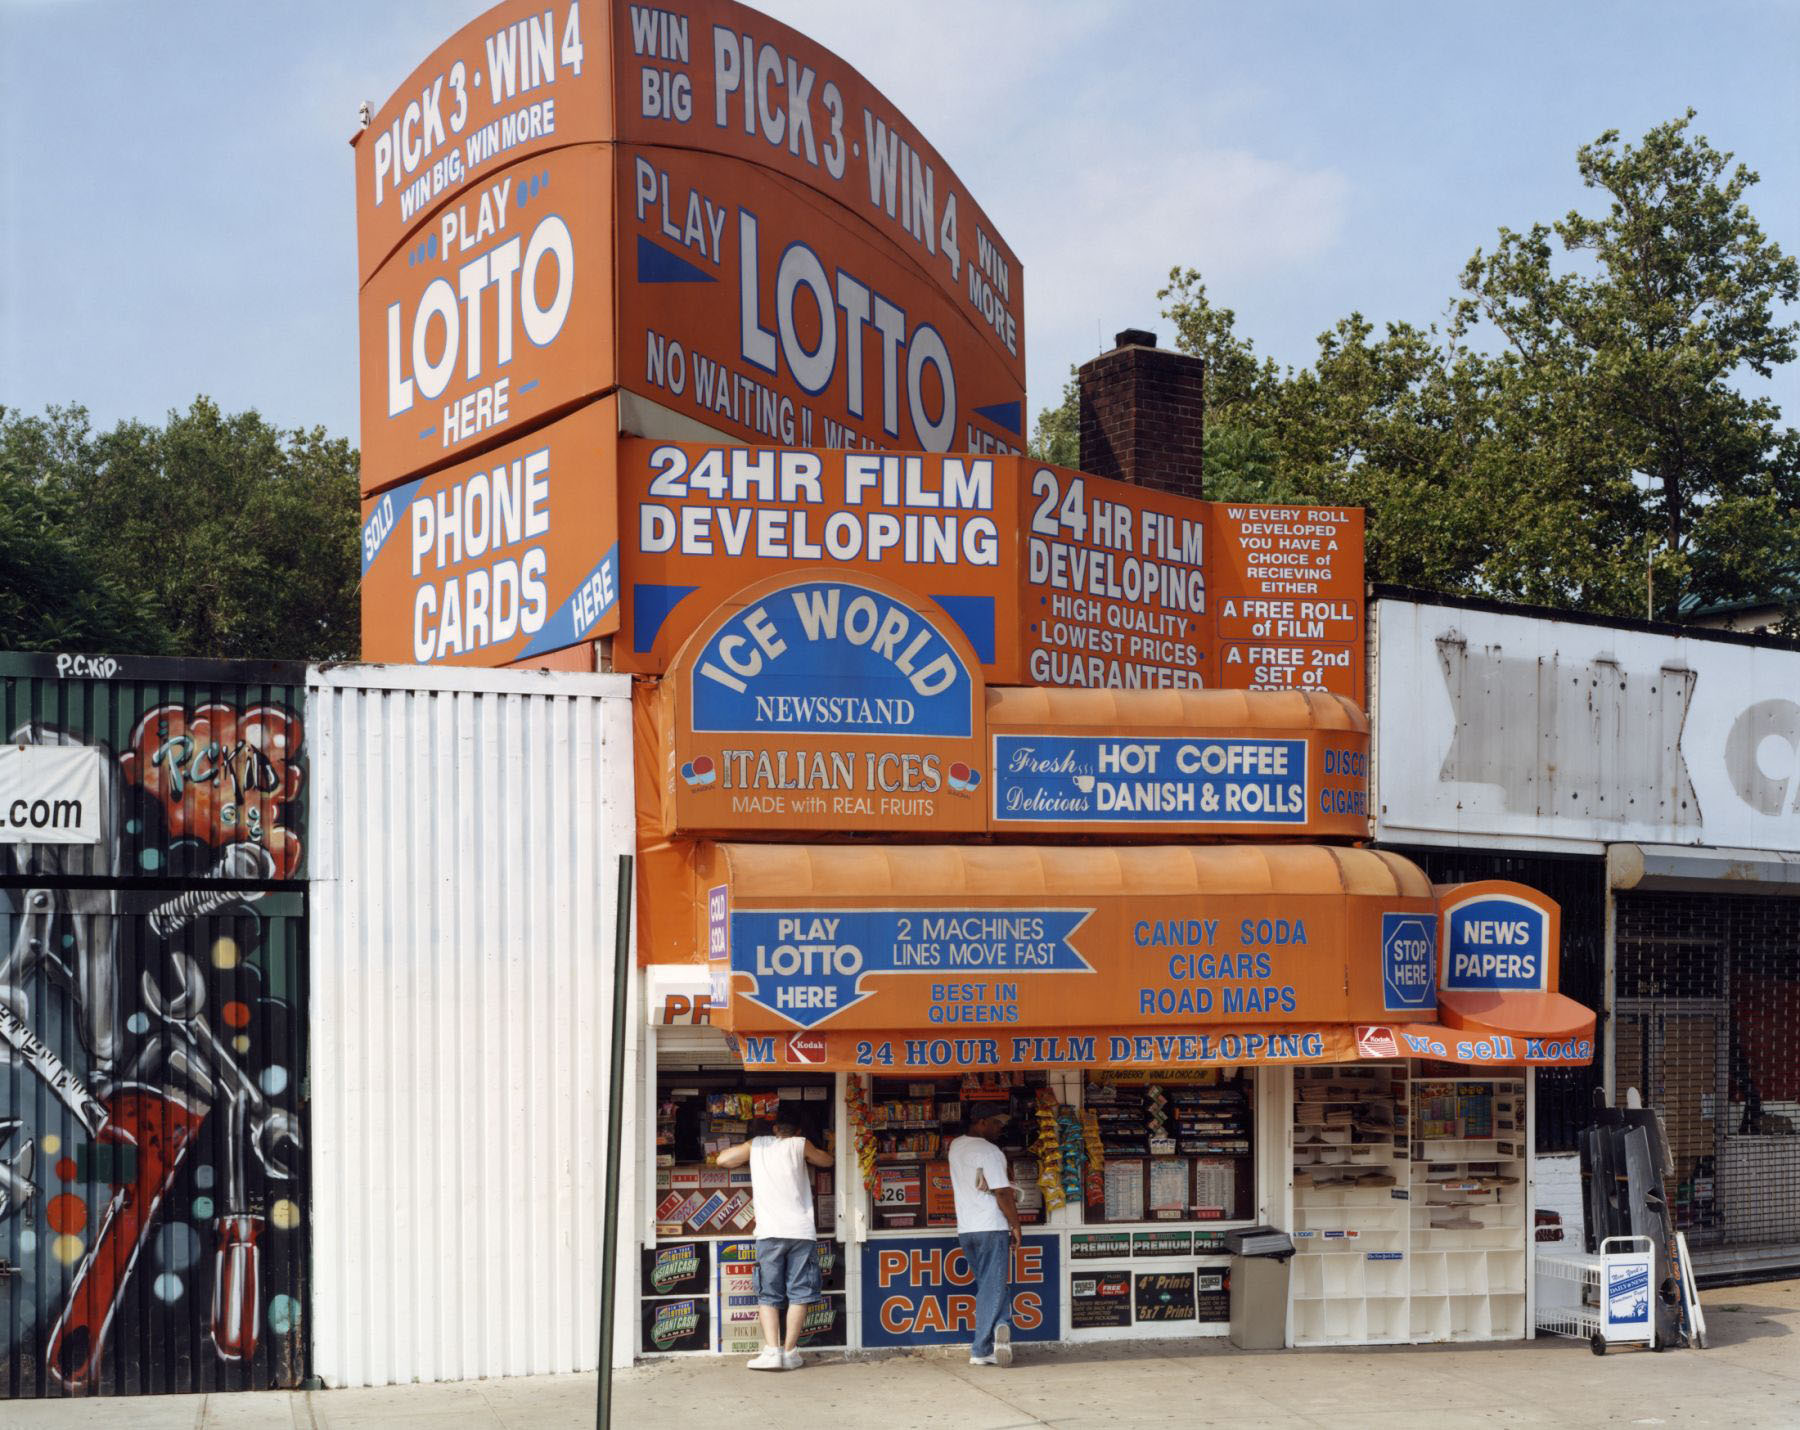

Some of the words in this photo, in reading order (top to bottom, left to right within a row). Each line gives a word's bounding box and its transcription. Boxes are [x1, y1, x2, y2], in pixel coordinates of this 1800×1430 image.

[630, 5, 690, 64] WIN
[375, 75, 446, 207] PICK
[449, 60, 468, 134] 3
[486, 10, 556, 104] WIN
[561, 0, 584, 76] 4
[641, 66, 693, 124] BIG
[400, 172, 431, 223] WIN
[433, 148, 464, 196] BIG,
[466, 120, 499, 168] WIN
[502, 99, 555, 150] MORE
[712, 23, 819, 168] PICK
[822, 80, 845, 181] 3
[863, 106, 936, 256] WIN
[940, 190, 960, 284] 4
[442, 176, 511, 262] PLAY
[635, 154, 726, 266] PLAY
[975, 224, 1009, 303] WIN
[388, 213, 575, 419] LOTTO
[967, 260, 1017, 358] MORE
[739, 206, 957, 452] LOTTO
[646, 328, 686, 396] NO
[692, 351, 795, 446] WAITING
[443, 378, 510, 448] HERE
[649, 446, 824, 504] 24HR
[845, 453, 994, 511] FILM
[411, 446, 549, 579] PHONE
[1031, 467, 1089, 543] 24
[1092, 498, 1133, 553] HR
[1141, 509, 1203, 568] FILM
[1308, 511, 1349, 523] ROLL
[364, 494, 394, 561] SOLD
[639, 502, 999, 567] DEVELOPING
[1241, 523, 1336, 536] DEVELOPED
[1239, 537, 1272, 549] YOU
[1279, 538, 1320, 550] HAVE
[1327, 540, 1338, 551] A
[1247, 552, 1309, 565] CHOICE
[1315, 554, 1331, 565] of
[1029, 536, 1205, 615] DEVELOPING
[1247, 567, 1332, 580] RECIEVING
[1261, 581, 1318, 594] EITHER
[413, 546, 547, 664] CARDS
[571, 559, 614, 639] HERE
[1223, 601, 1237, 617] A
[1243, 601, 1294, 618] FREE
[1301, 602, 1354, 621] ROLL
[1052, 594, 1101, 625] HIGH
[1106, 604, 1188, 638] QUALITY
[1252, 619, 1272, 637] of
[1277, 621, 1324, 638] FILM
[700, 606, 788, 694] ICE
[791, 588, 958, 697] WORLD
[1040, 619, 1124, 657] LOWEST
[1129, 635, 1198, 667] PRICES
[1226, 647, 1242, 664] A
[1249, 647, 1305, 665] FREE
[1311, 649, 1349, 666] 2nd
[1255, 666, 1293, 684] SET
[1302, 666, 1324, 684] of
[755, 696, 915, 725] NEWSSTAND
[721, 750, 856, 790] ITALIAN
[866, 752, 942, 793] ICES
[1008, 747, 1075, 774] Fresh
[1099, 745, 1160, 773] HOT
[1176, 745, 1289, 775] COFFEE
[732, 796, 785, 814] MADE
[792, 797, 827, 814] with
[833, 797, 875, 815] REAL
[881, 798, 935, 817] FRUITS
[1006, 786, 1090, 812] Delicious
[1097, 783, 1195, 811] DANISH
[1200, 783, 1220, 812] &
[1225, 784, 1304, 814] ROLLS
[711, 894, 725, 922] COLD
[711, 926, 726, 953] SODA
[778, 918, 840, 941] PLAY
[897, 918, 911, 941] 2
[922, 918, 1044, 940] MACHINES
[1133, 919, 1220, 947] CANDY
[1240, 919, 1308, 946] SODA
[1463, 920, 1530, 945] NEWS
[756, 944, 864, 977] LOTTO
[892, 943, 941, 966] LINES
[949, 943, 1007, 966] MOVE
[1015, 943, 1056, 965] FAST
[1393, 940, 1427, 961] STOP
[1168, 953, 1272, 980] CIGARS
[1394, 964, 1427, 985] HERE
[1454, 954, 1536, 979] PAPERS
[776, 985, 838, 1009] HERE
[931, 983, 988, 1002] BEST
[995, 983, 1017, 1001] IN
[1139, 987, 1214, 1015] ROAD
[1222, 985, 1297, 1013] MAPS
[928, 1005, 1019, 1023] QUEENS
[797, 1040, 824, 1049] Kodak
[856, 1040, 895, 1066] 24
[905, 1039, 1001, 1066] HOUR
[1010, 1036, 1097, 1063] FILM
[1109, 1032, 1325, 1061] DEVELOPING
[1370, 1035, 1391, 1043] Kodak
[1401, 1033, 1447, 1057] We
[1457, 1036, 1516, 1060] sell
[1071, 1242, 1129, 1252] PREMIUM
[1133, 1240, 1190, 1250] PREMIUM
[878, 1246, 1044, 1288] PHOE
[1156, 1275, 1191, 1289] Prints
[1610, 1283, 1627, 1294] DAILY
[1631, 1276, 1648, 1288] NEWS
[880, 1291, 1043, 1335] CARS
[1165, 1305, 1193, 1319] Prints
